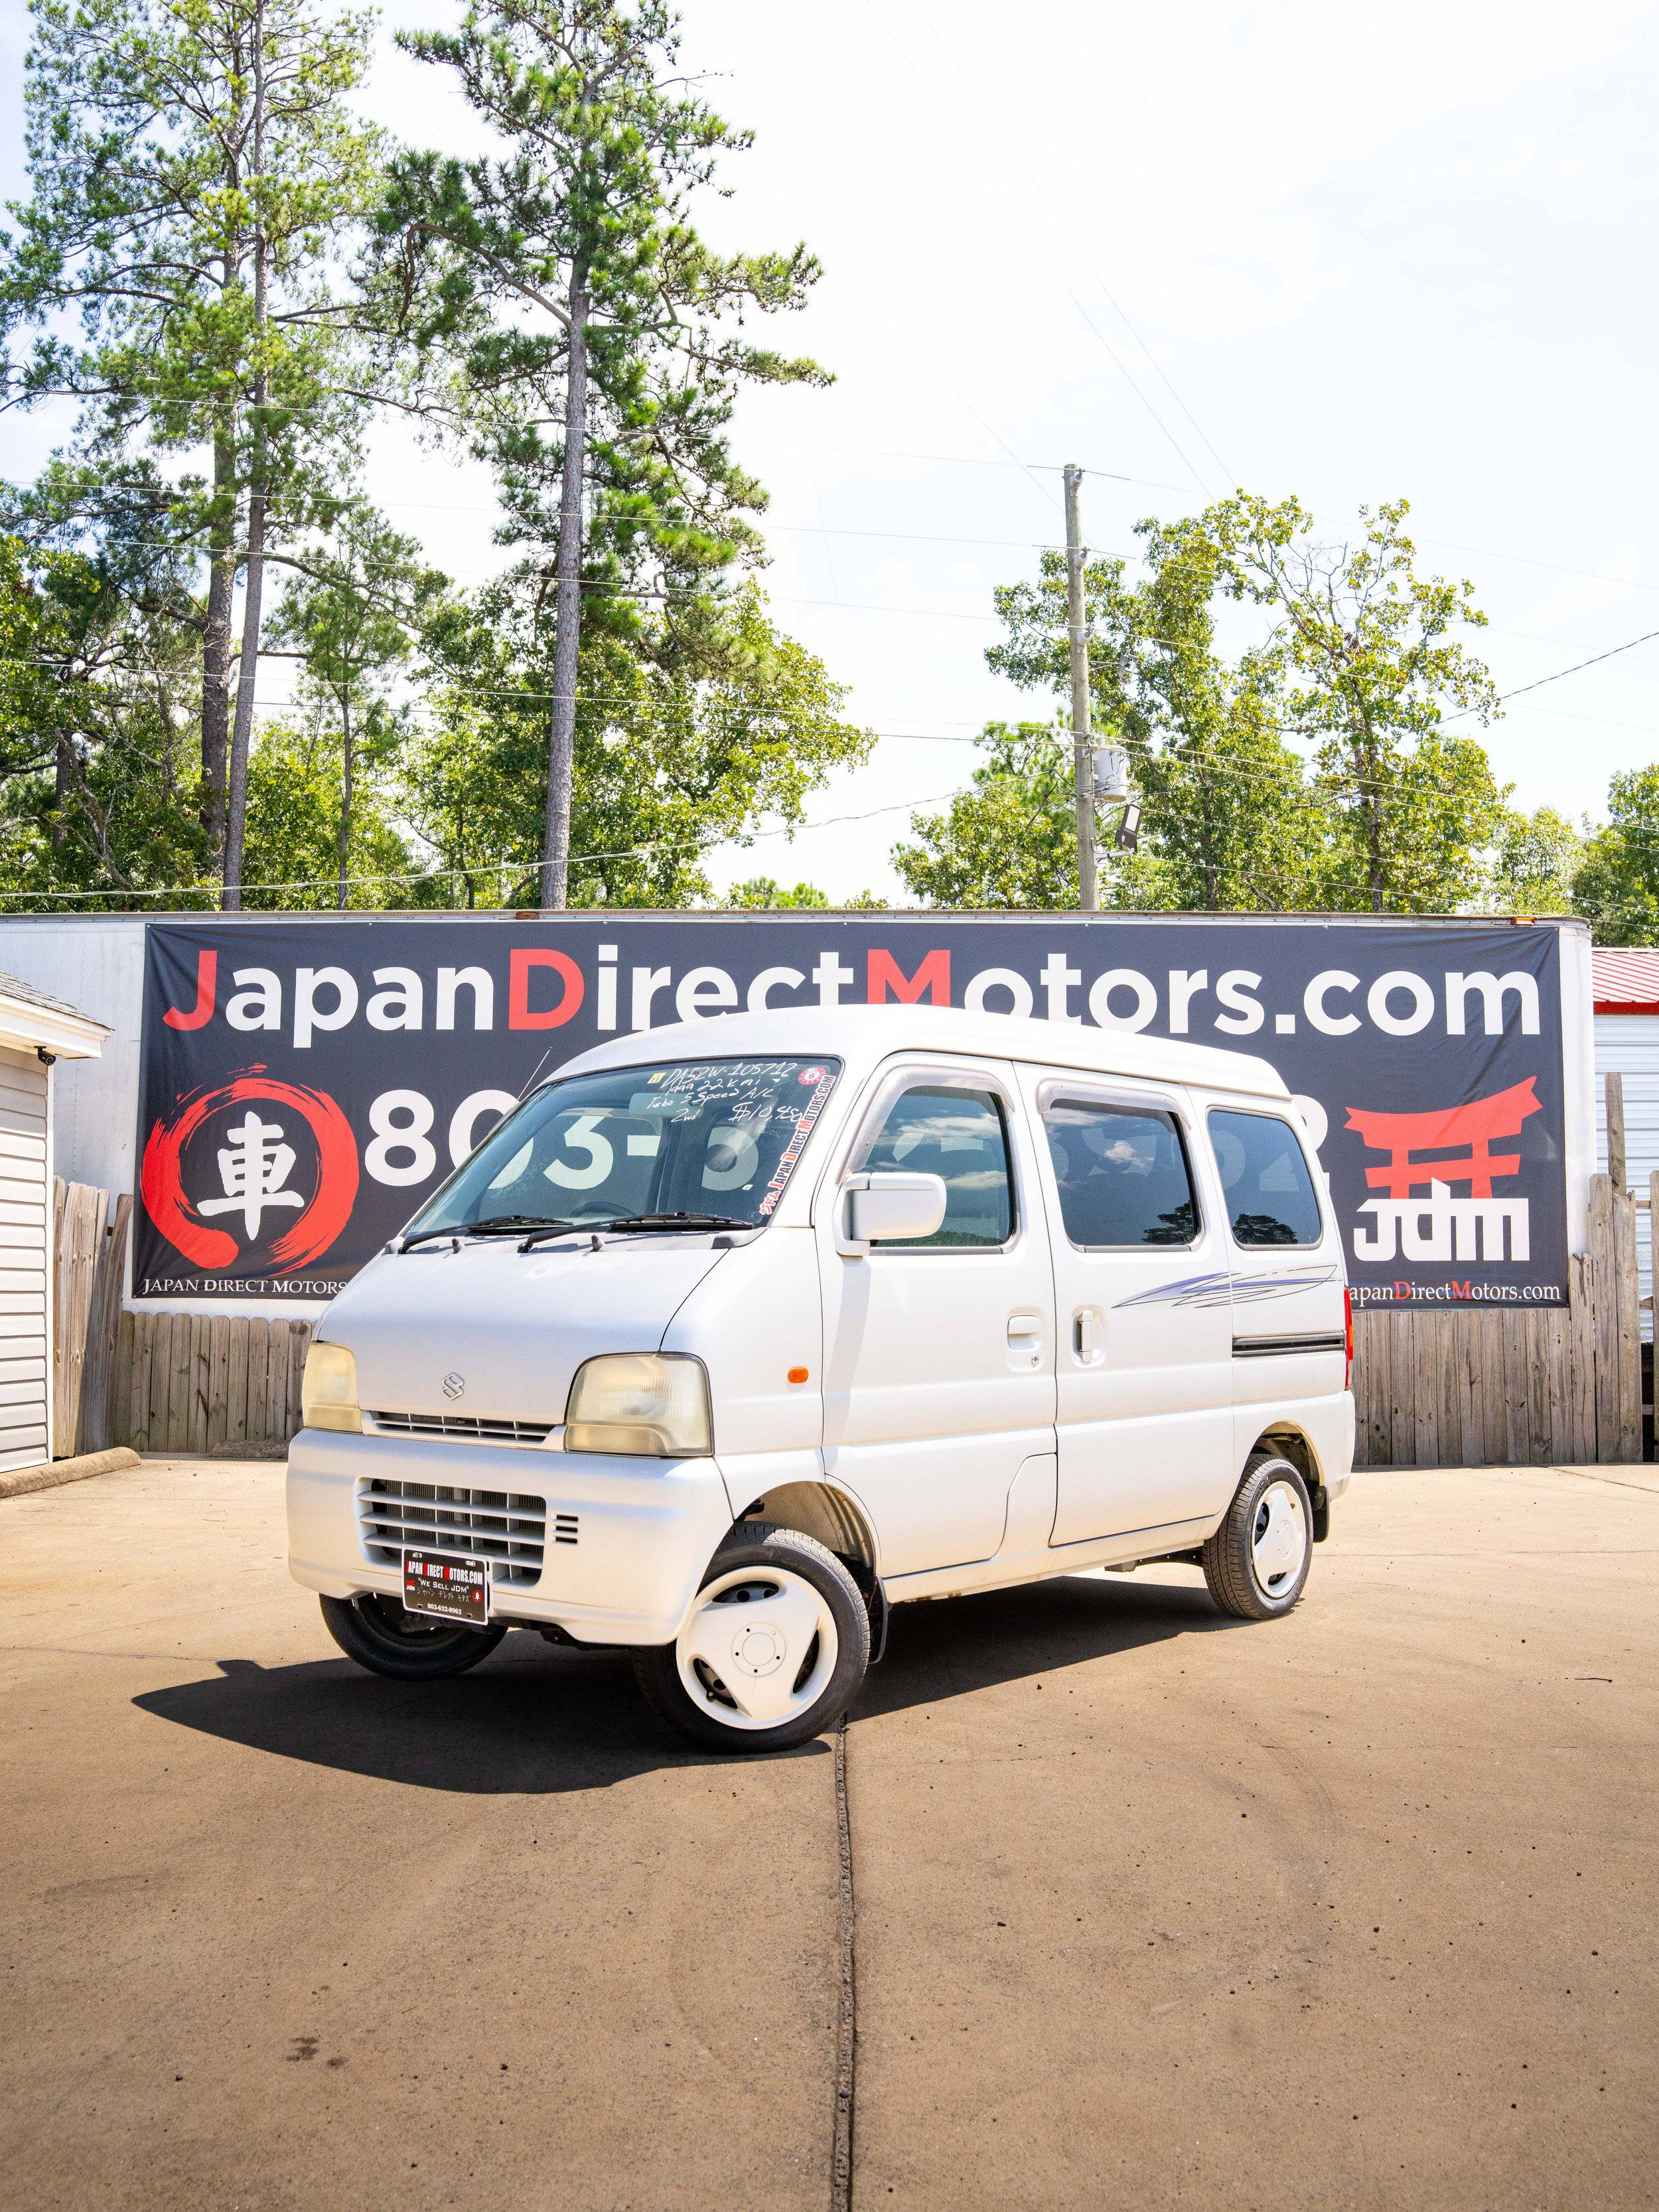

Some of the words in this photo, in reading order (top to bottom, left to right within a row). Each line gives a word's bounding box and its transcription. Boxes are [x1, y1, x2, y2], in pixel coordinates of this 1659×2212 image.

[162, 944, 1541, 1049] JapanDirectMotors.com
[646, 1096, 674, 1110] Turbo
[680, 1092, 695, 1104] 5
[691, 1088, 739, 1107] Speed
[665, 1083, 694, 1096] 1999
[197, 1111, 305, 1240] 車
[143, 1278, 198, 1294] JAPAN
[204, 1280, 268, 1292] DIRECT
[1349, 1281, 1561, 1307] apanDirectMotors.com
[433, 1582, 449, 1590] SELL
